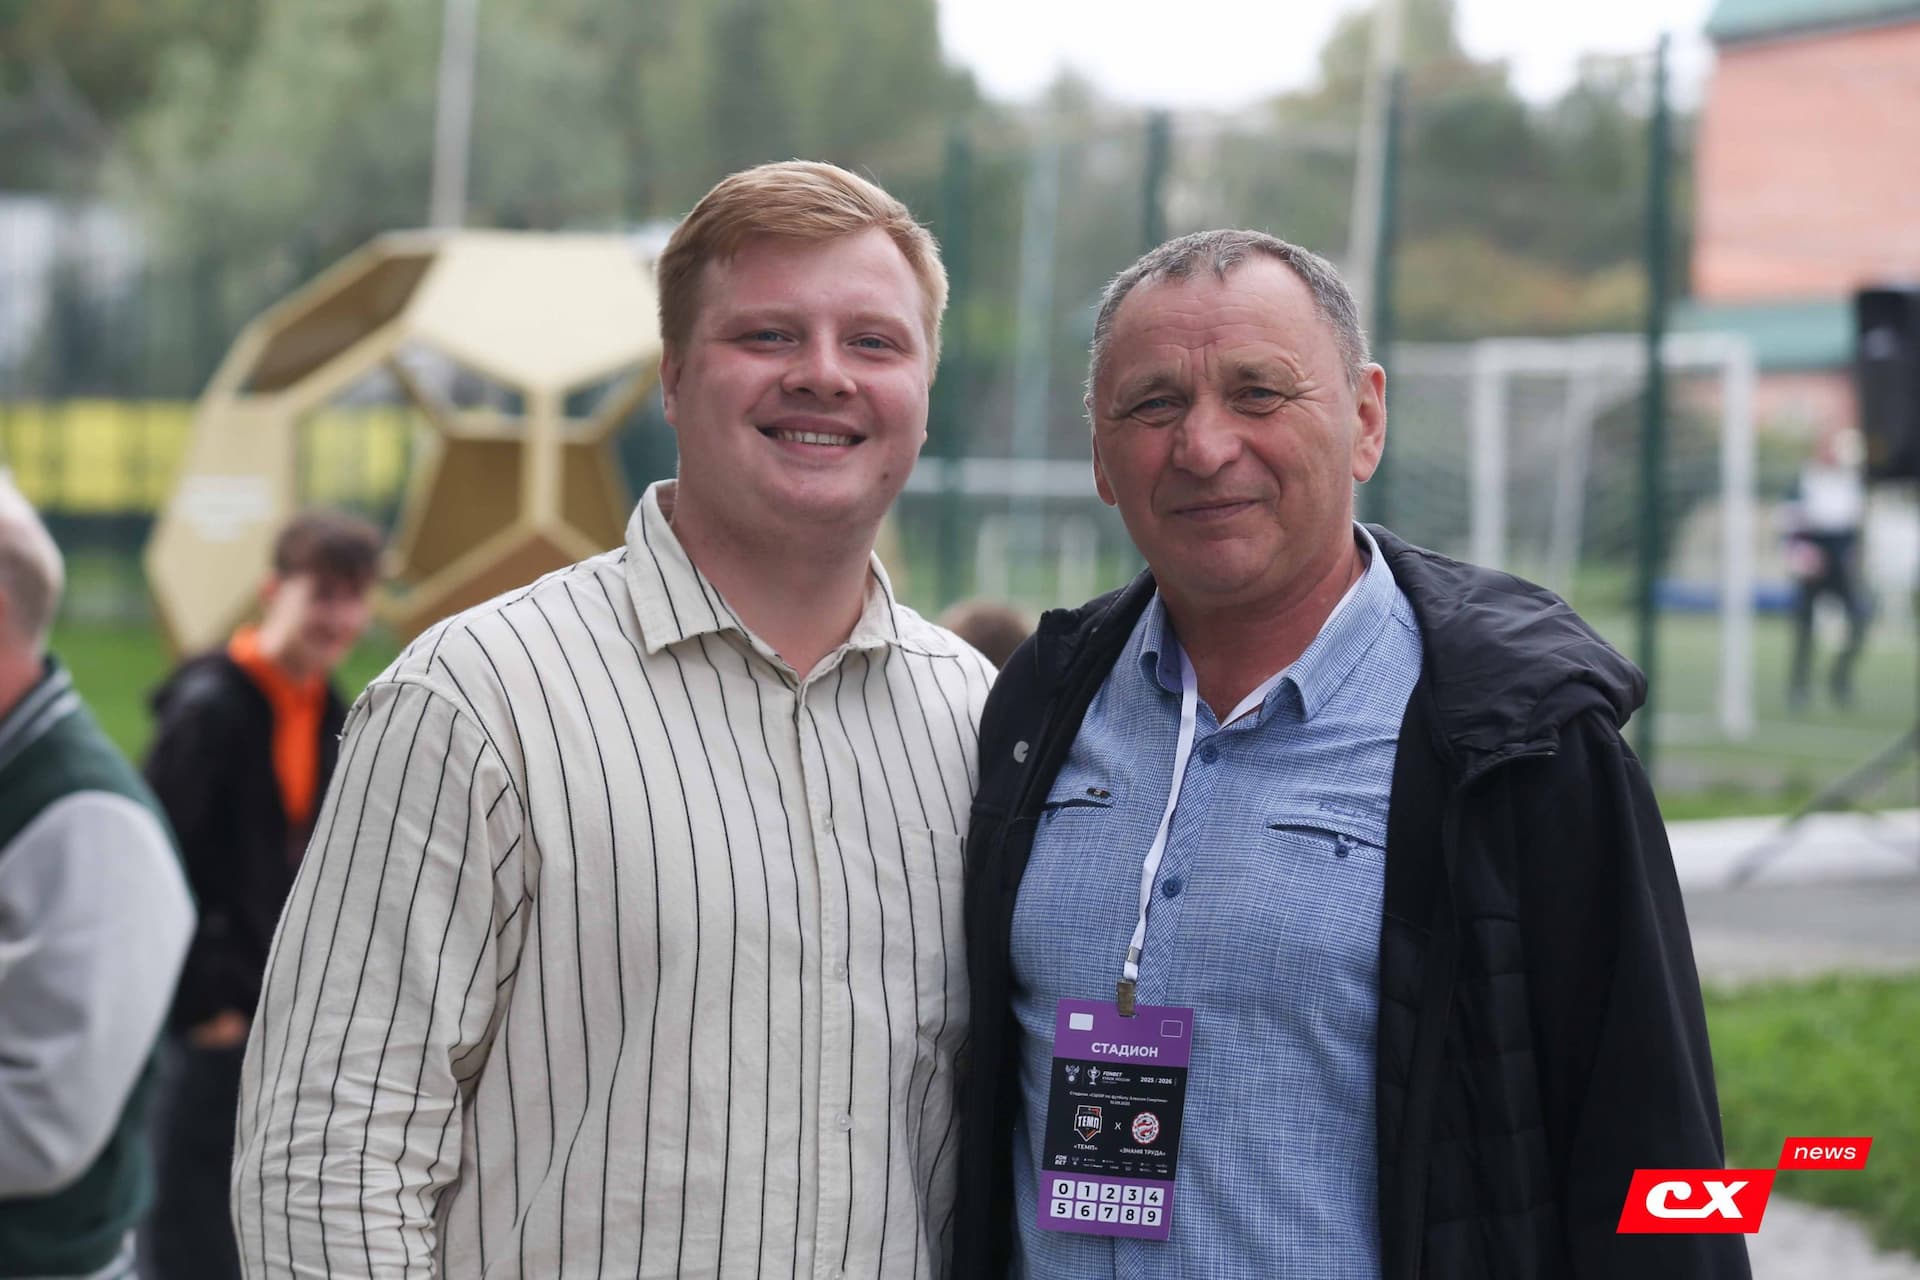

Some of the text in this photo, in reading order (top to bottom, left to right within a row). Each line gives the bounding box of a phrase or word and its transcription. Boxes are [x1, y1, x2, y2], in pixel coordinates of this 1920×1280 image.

[1091, 1042, 1159, 1058] СТАДИОН
[1078, 1115, 1099, 1129] ТЕМП
[1058, 1183, 1159, 1203] 0 1 2 3 4
[1056, 1202, 1156, 1222] 5 6 7 8 9
